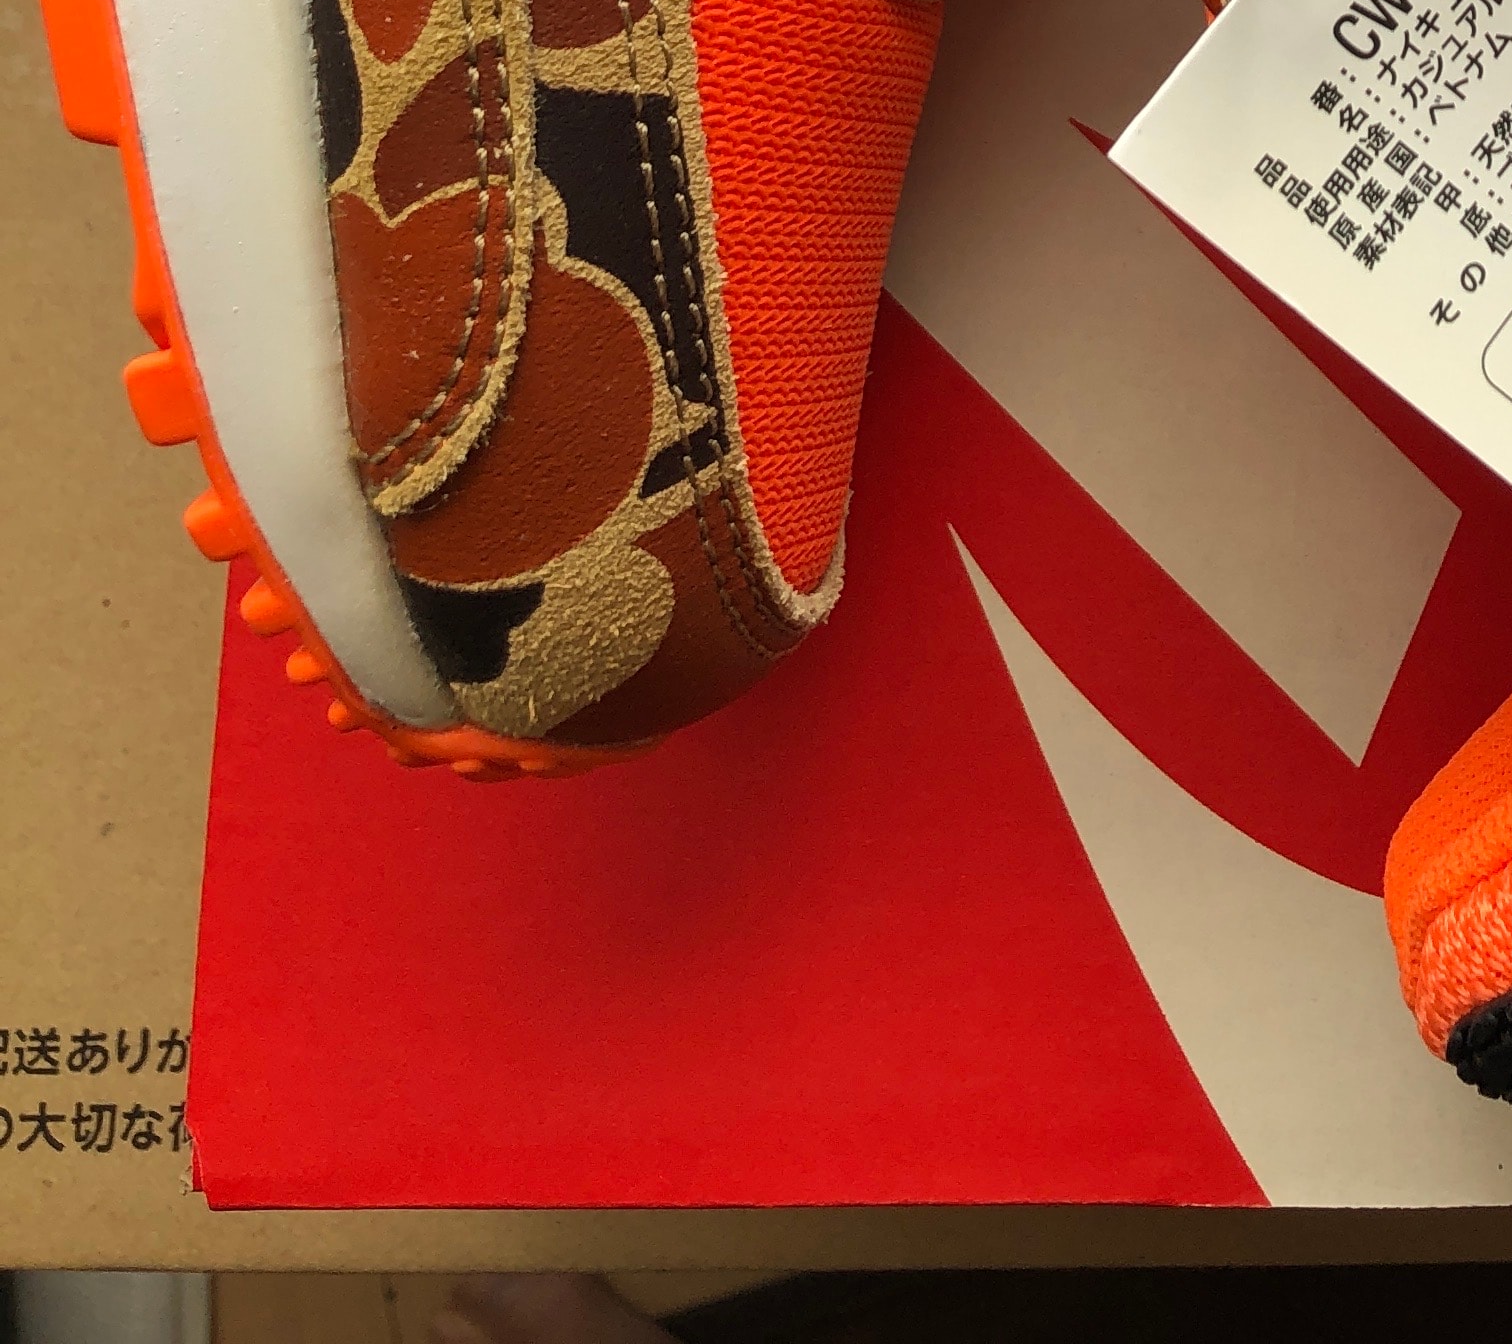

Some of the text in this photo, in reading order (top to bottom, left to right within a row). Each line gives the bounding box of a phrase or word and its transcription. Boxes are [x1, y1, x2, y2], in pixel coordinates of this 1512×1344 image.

[1352, 160, 1443, 271] 素材表記
[0, 1101, 193, 1153] 大切な
